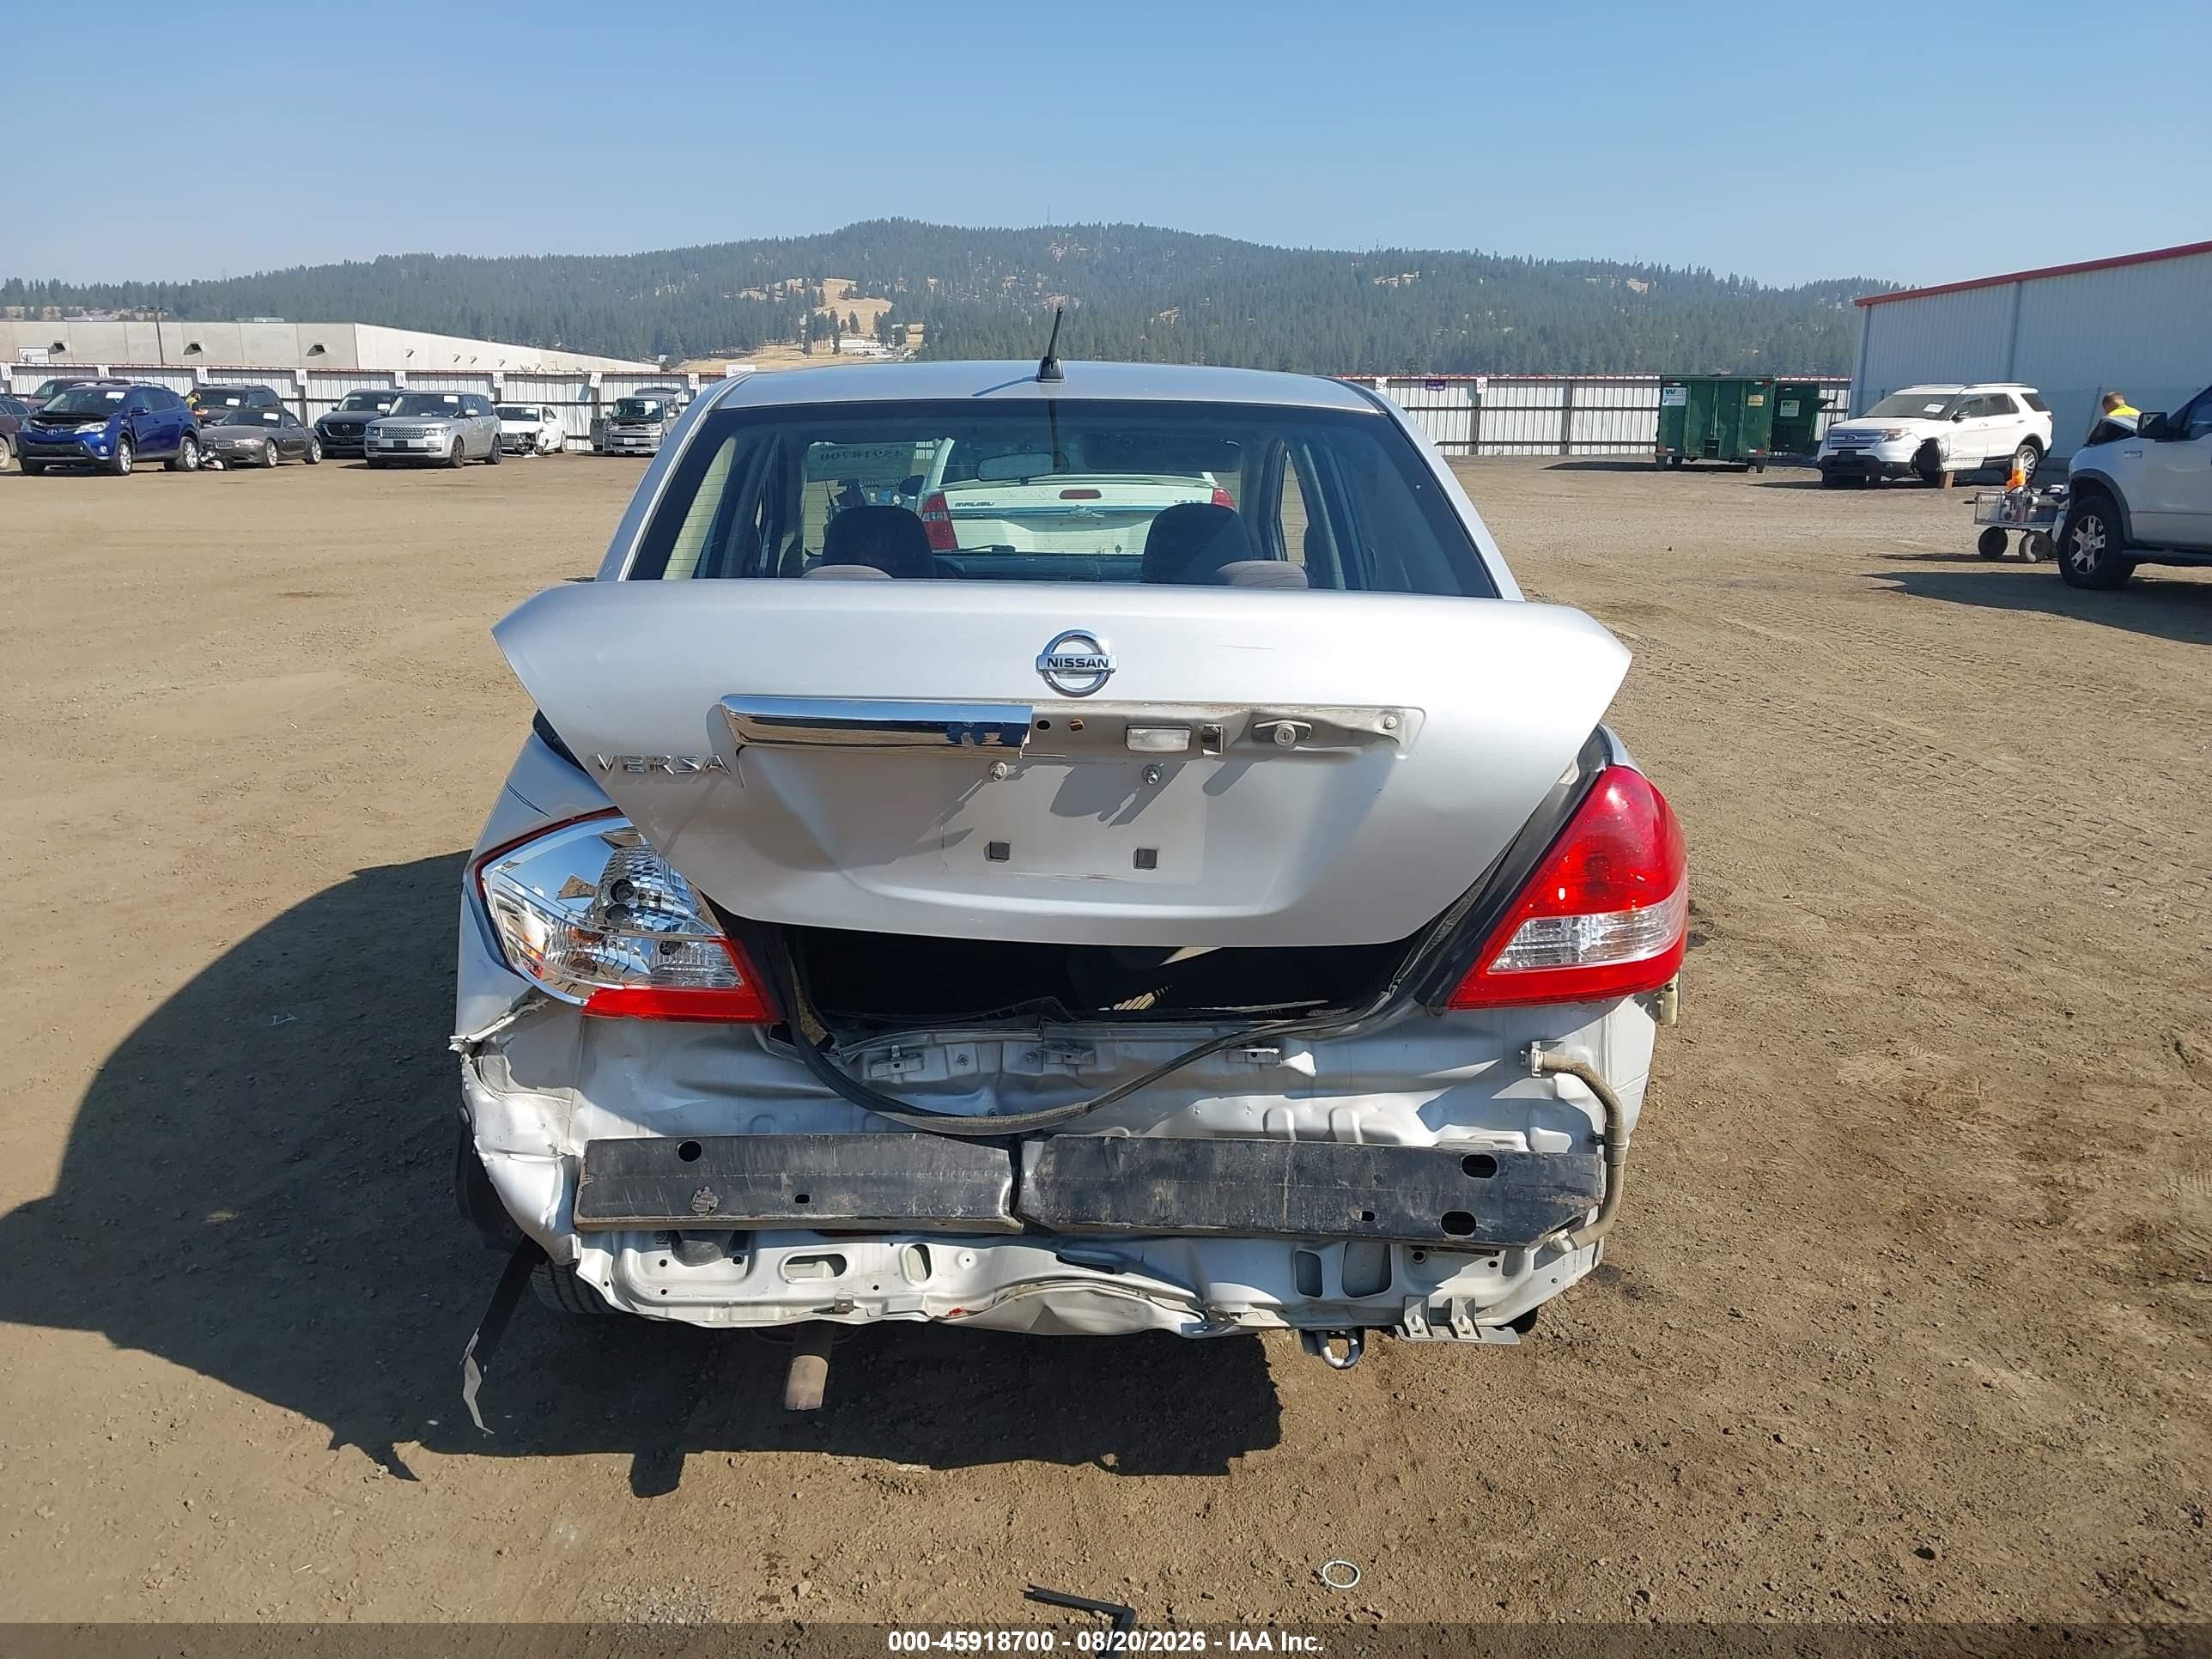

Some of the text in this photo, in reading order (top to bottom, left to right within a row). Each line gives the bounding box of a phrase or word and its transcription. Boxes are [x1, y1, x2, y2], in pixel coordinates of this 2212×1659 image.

[689, 377, 699, 386] 22
[1376, 381, 1386, 390] 29
[1477, 381, 1487, 390] 30
[1047, 658, 1109, 668] NISSAN
[597, 753, 731, 775] VERSA
